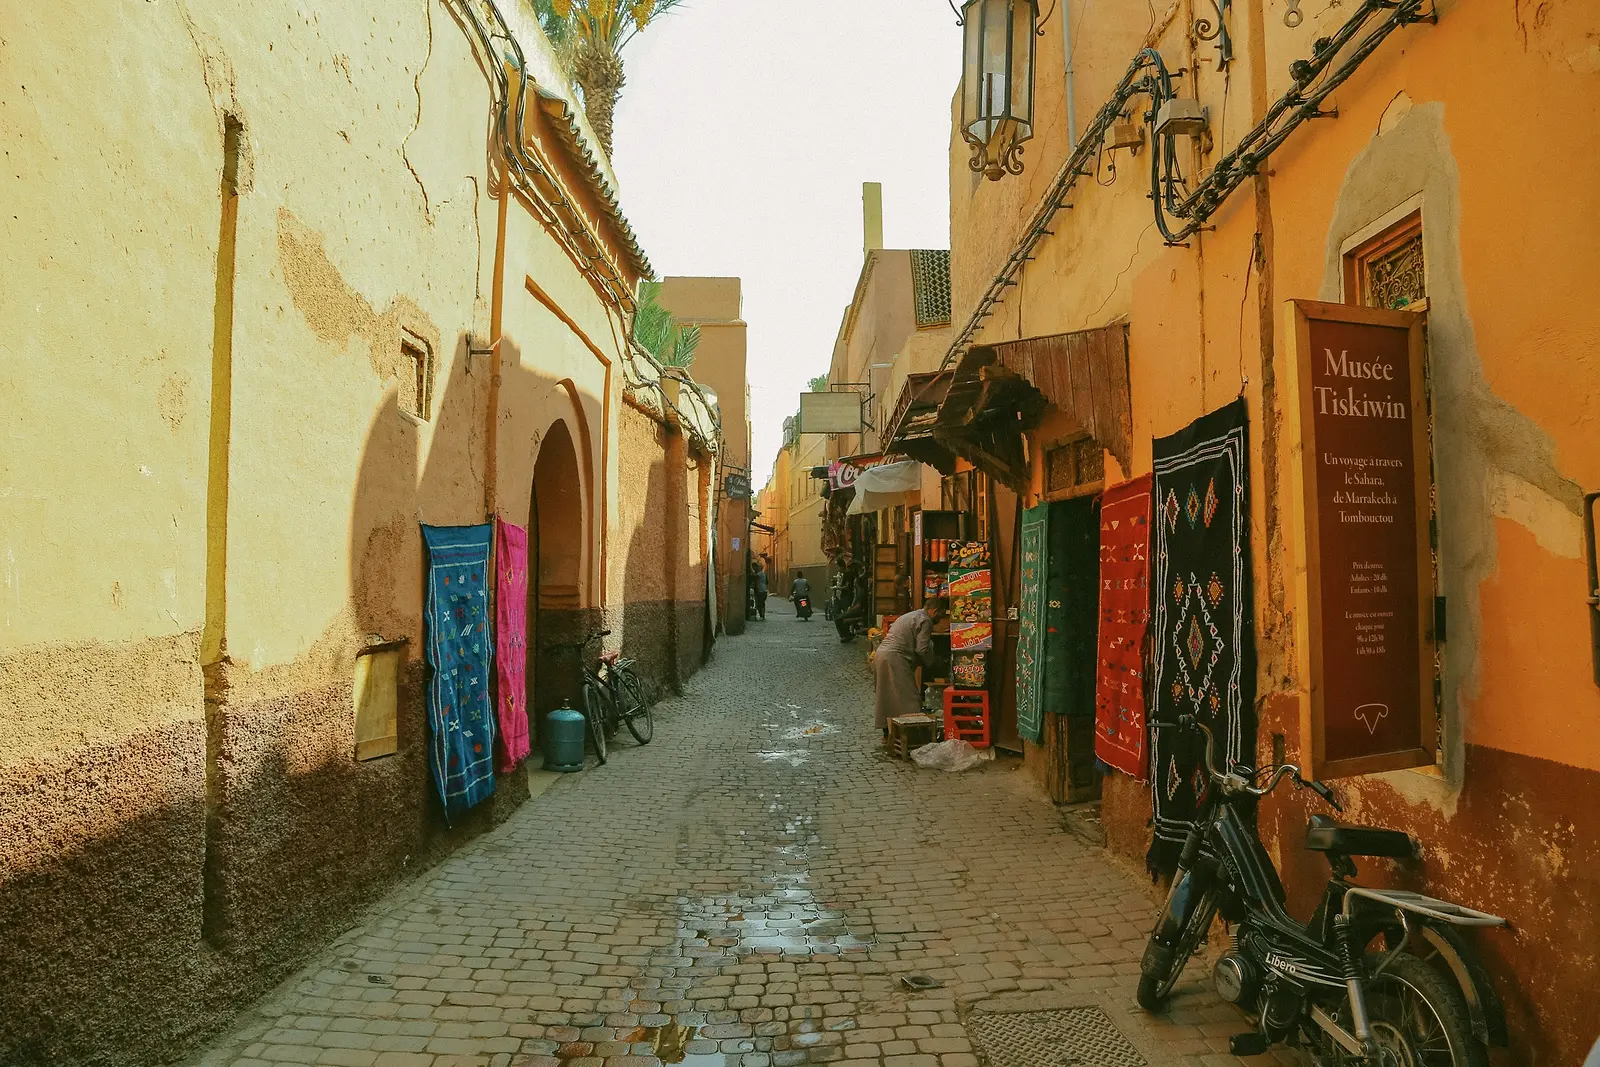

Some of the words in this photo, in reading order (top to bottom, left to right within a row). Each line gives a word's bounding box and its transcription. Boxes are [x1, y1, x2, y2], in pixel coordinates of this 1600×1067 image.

[1323, 347, 1394, 381] Musée
[1313, 386, 1406, 419] Tiskiwin
[1324, 452, 1338, 465] Un
[1339, 457, 1368, 471] voyage
[1375, 458, 1403, 468] travers
[1344, 471, 1353, 485] le
[1353, 472, 1385, 487] Sahara,
[1333, 490, 1344, 504] de
[1345, 491, 1391, 504] Marrakech
[1338, 510, 1394, 523] Tombouctou
[1265, 952, 1296, 974] Libero
